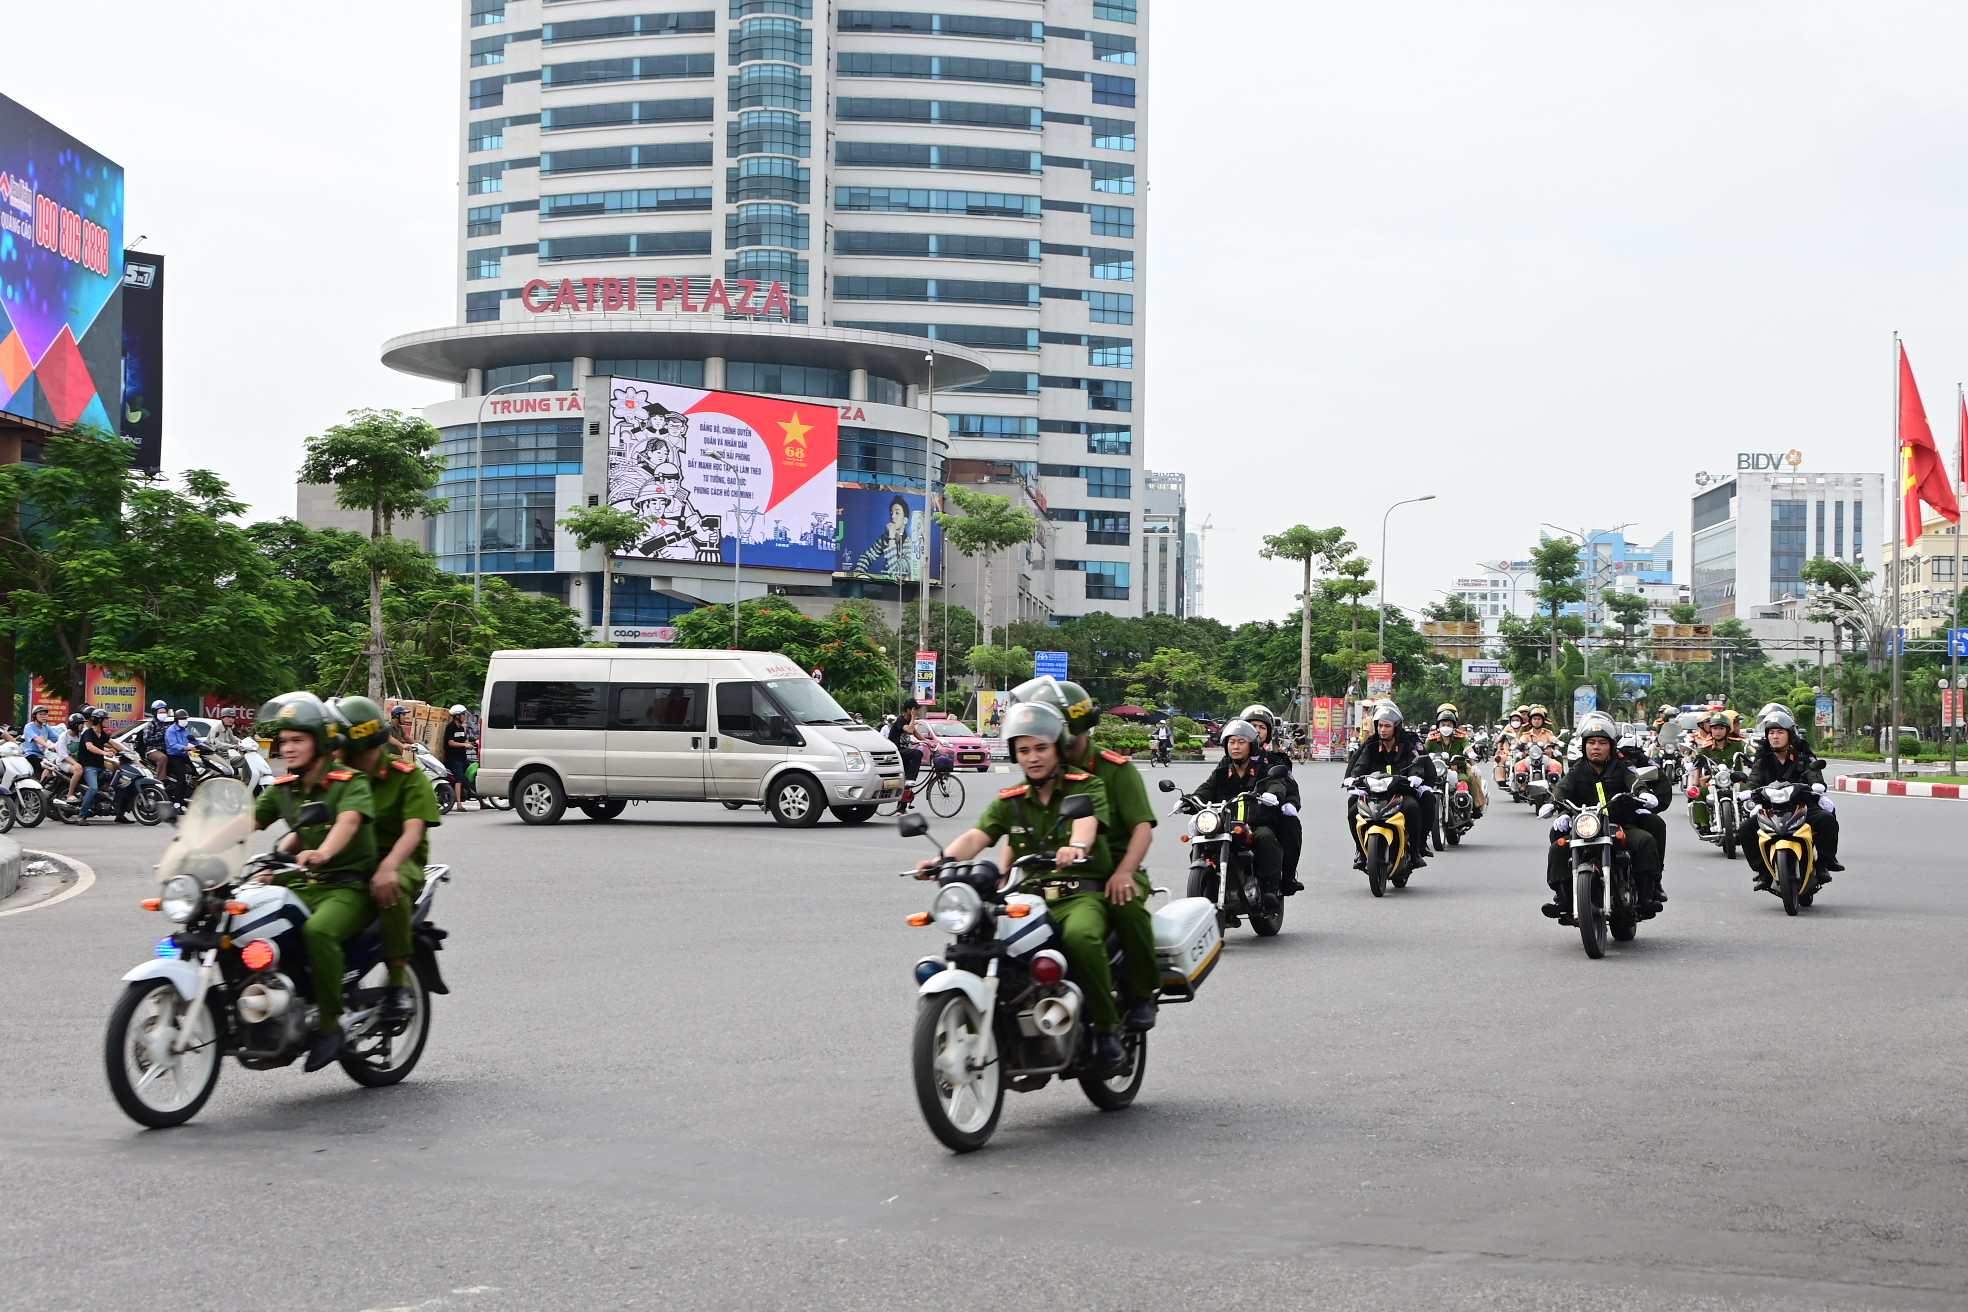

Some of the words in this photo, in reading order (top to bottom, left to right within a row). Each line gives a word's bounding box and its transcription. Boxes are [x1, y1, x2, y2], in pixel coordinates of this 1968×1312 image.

[21, 220, 32, 240] CÁO
[36, 194, 58, 252] 090
[60, 207, 81, 263] 806
[82, 219, 109, 277] 8888
[521, 277, 638, 313] CATBI
[656, 277, 790, 316] PLAZA
[490, 397, 551, 415] TRUNG
[784, 446, 805, 459] 68
[1737, 453, 1784, 470] BIDV
[750, 466, 762, 476] THEO
[694, 486, 710, 495] PHONG
